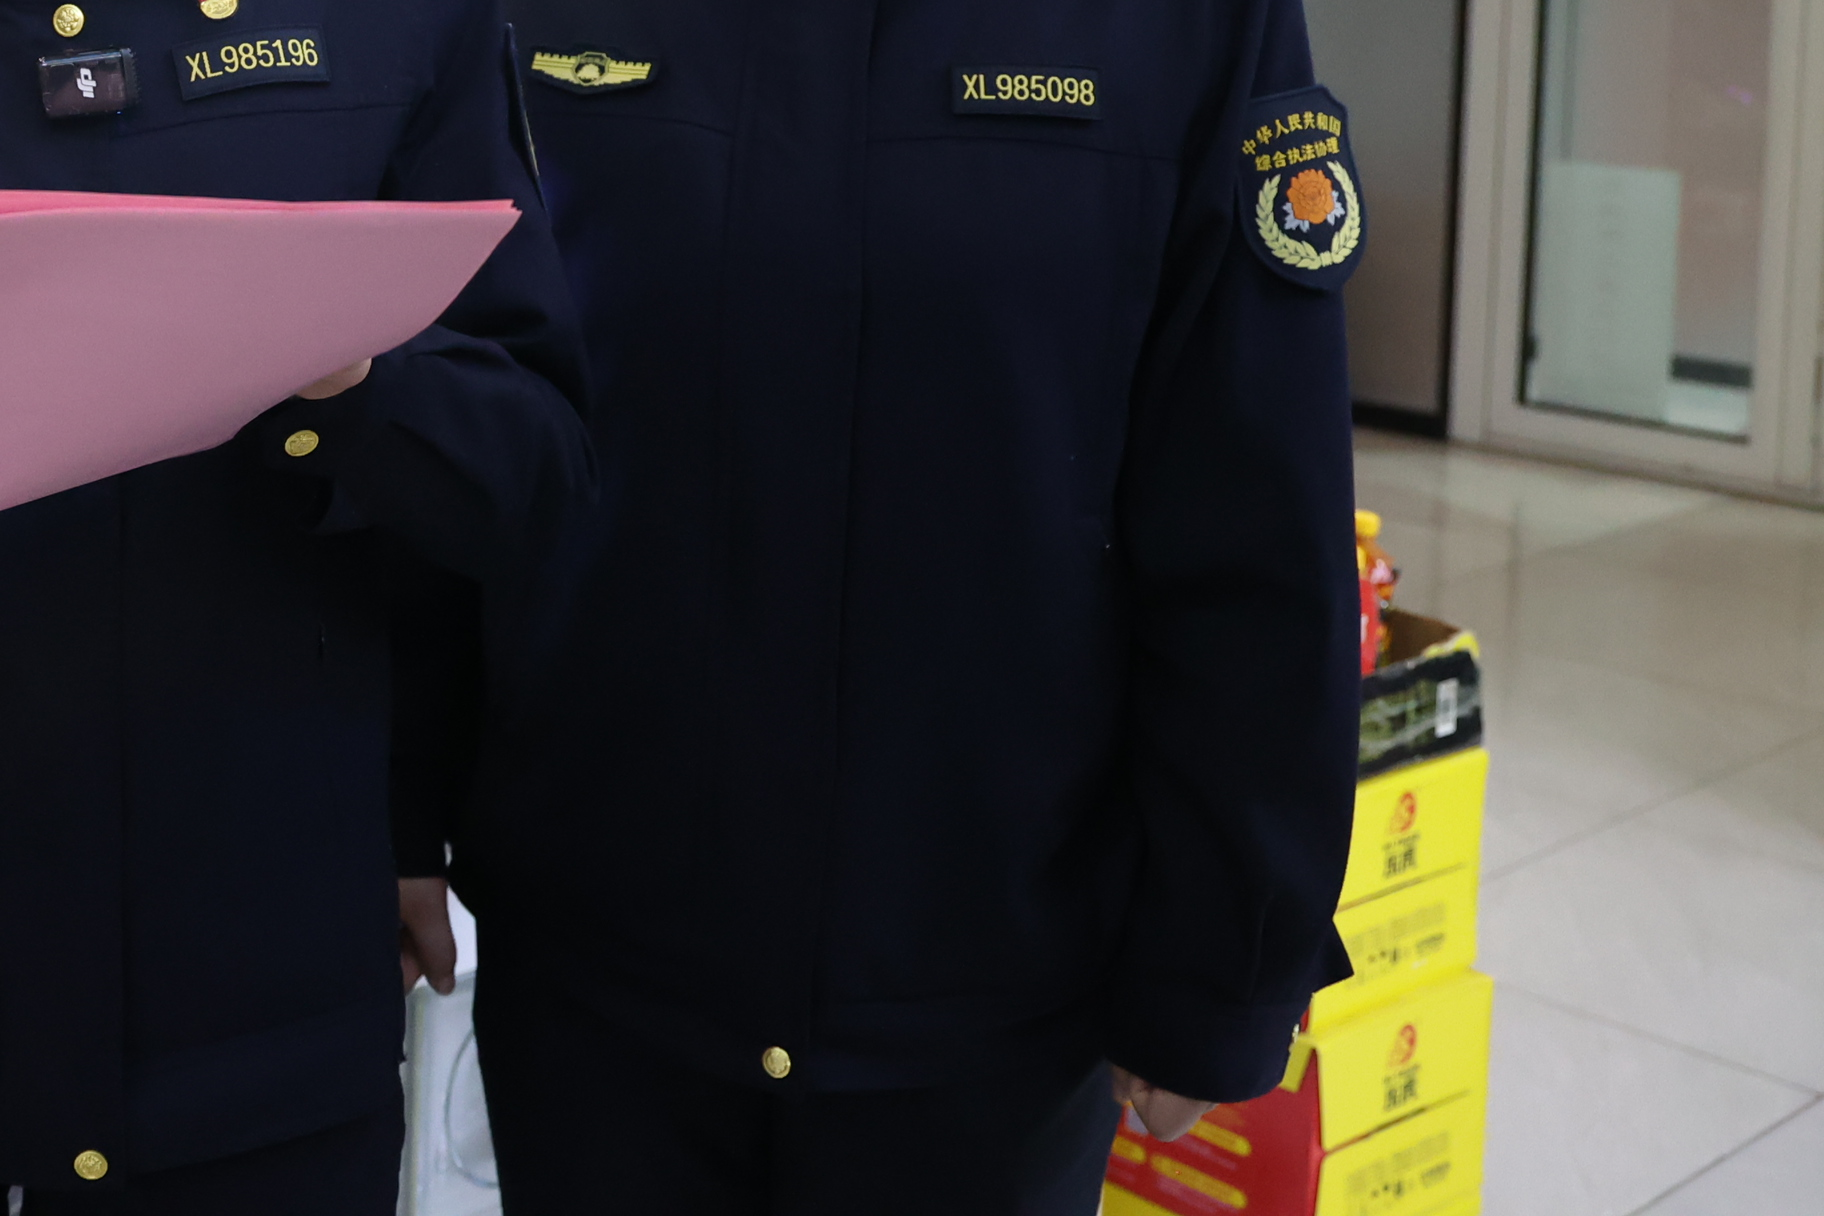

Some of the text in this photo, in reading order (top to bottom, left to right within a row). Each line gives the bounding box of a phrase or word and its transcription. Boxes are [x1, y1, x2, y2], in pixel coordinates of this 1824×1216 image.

[185, 38, 318, 82] XL985196
[962, 74, 1095, 106] XL985098
[1241, 110, 1342, 156] 中华人民共和国
[1255, 136, 1340, 171] 综合执法协理
